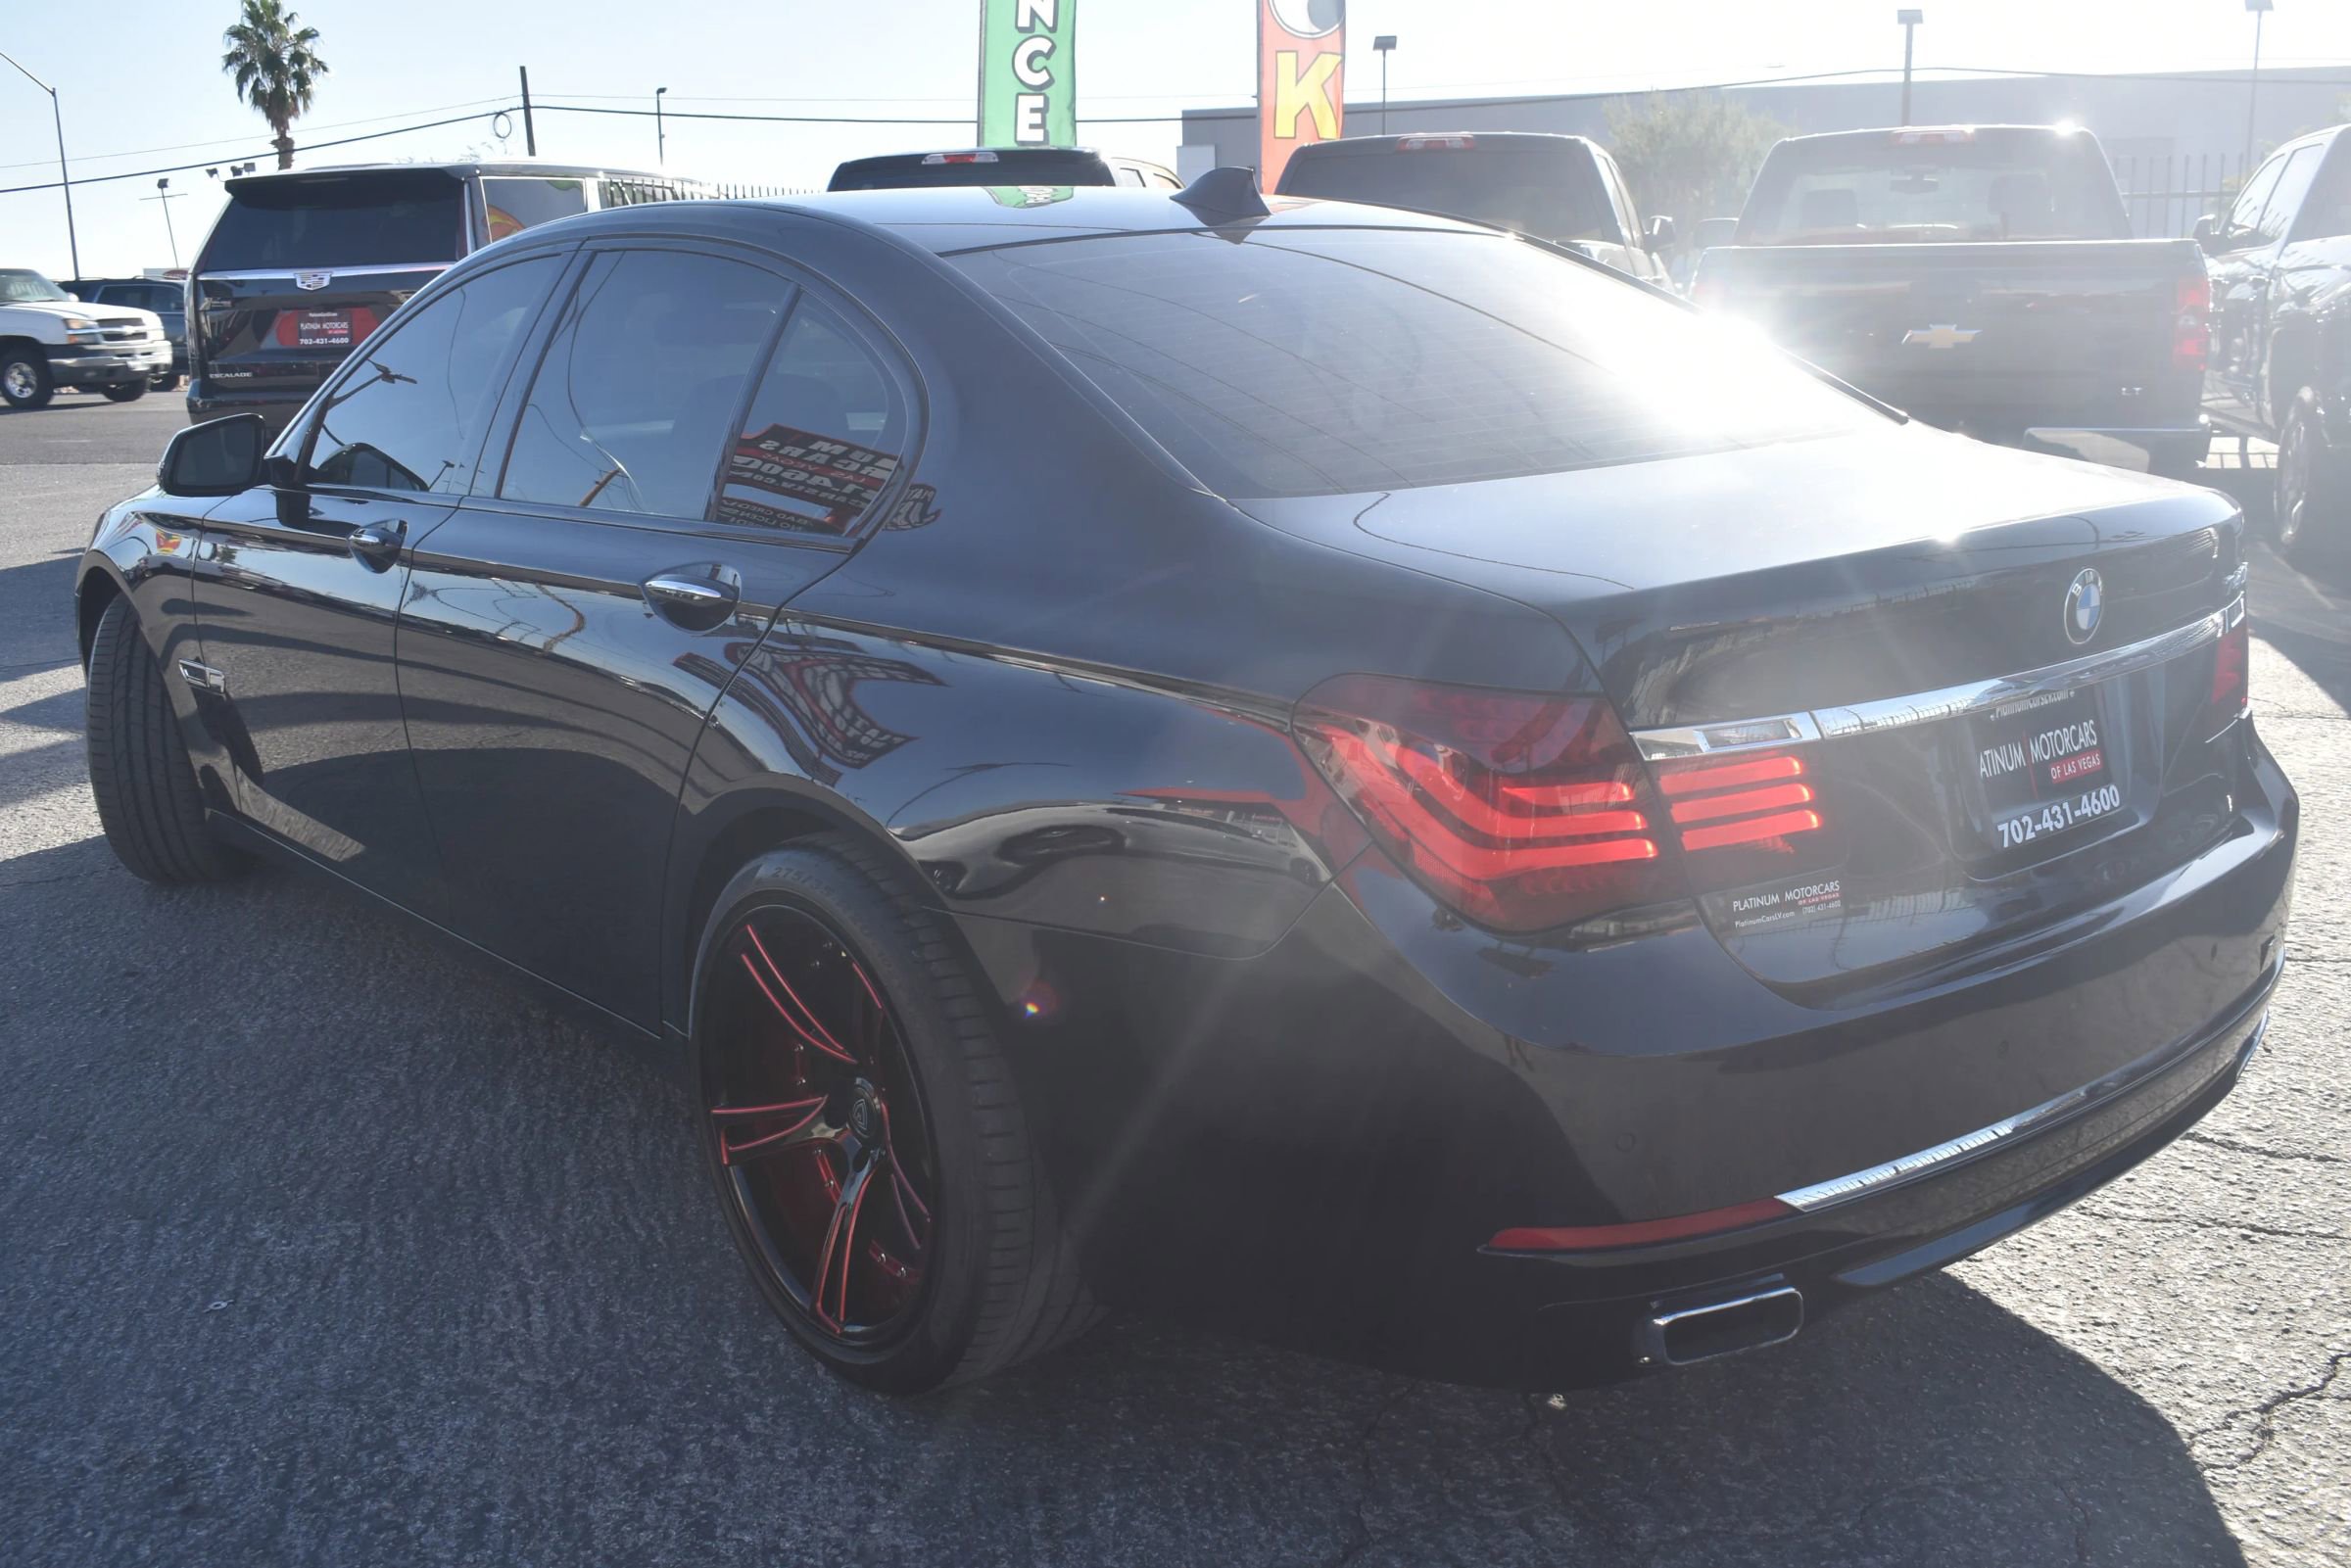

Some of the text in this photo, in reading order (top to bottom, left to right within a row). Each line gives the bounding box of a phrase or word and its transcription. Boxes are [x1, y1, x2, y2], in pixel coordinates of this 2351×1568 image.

[2029, 719, 2098, 765] MOTORCARS
[2050, 753, 2101, 780] OF LAS VEGAS
[1997, 784, 2121, 848] 702-431-4600
[1732, 879, 1841, 913] PLATINUM MOTORCARS
